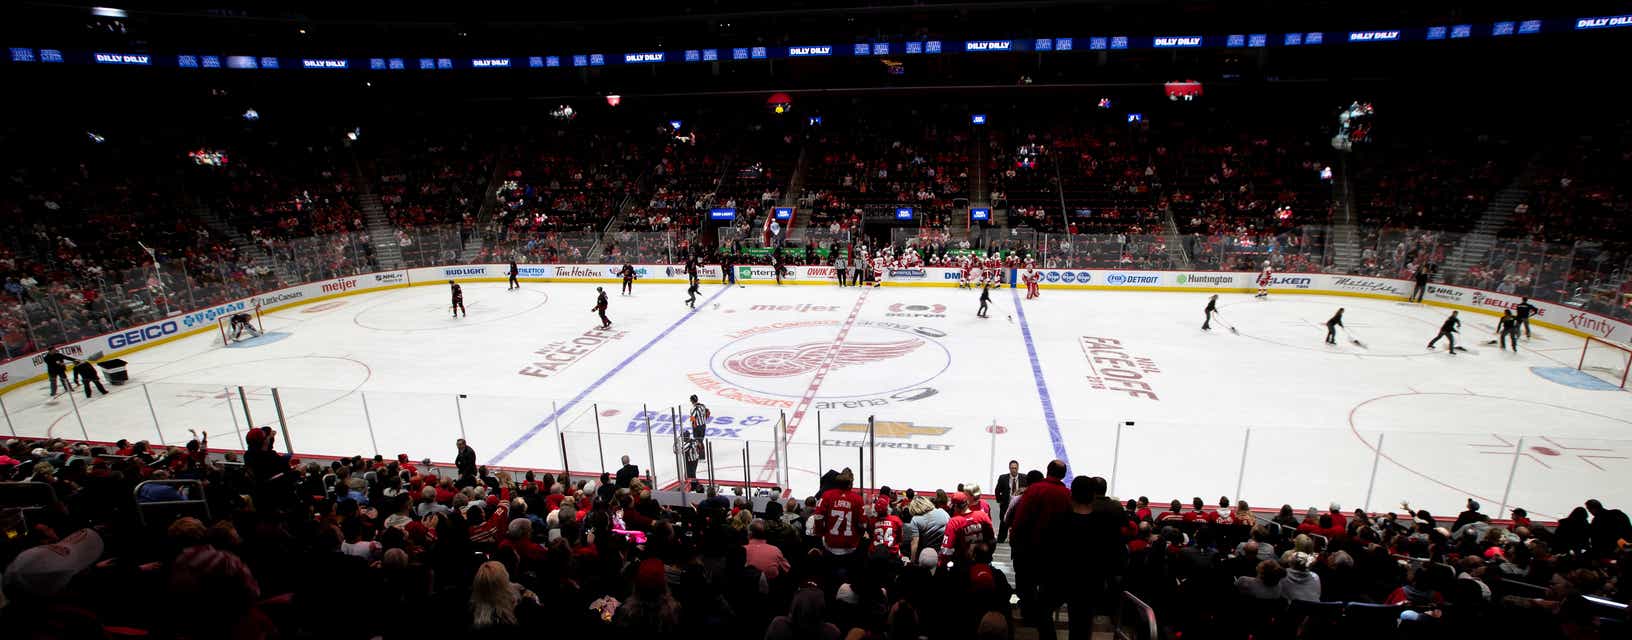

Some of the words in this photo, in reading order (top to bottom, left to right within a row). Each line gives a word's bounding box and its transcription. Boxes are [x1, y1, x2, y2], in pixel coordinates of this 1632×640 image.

[1578, 19, 1608, 27] DILLY
[1609, 17, 1632, 26] DILL
[1351, 32, 1373, 40] DILLY
[1374, 31, 1398, 39] DILLY
[967, 42, 988, 50] DILLY
[1155, 38, 1178, 46] DILLY
[1178, 37, 1200, 45] DILLY
[96, 54, 122, 62] DILLY
[123, 55, 148, 64] DILLY
[626, 54, 644, 62] DILLY
[554, 266, 571, 277] Tim
[571, 266, 601, 277] Hortons
[702, 267, 716, 275] First
[807, 267, 828, 276] QWIK
[944, 272, 961, 280] DM
[1127, 275, 1159, 284] DETROIT
[1188, 274, 1233, 285] Huntington
[321, 278, 358, 294] meijer
[750, 303, 841, 313] meijer
[1484, 297, 1517, 311] BELLE
[1568, 312, 1616, 338] xfinity
[108, 320, 178, 349] GEICO
[32, 344, 83, 368] HOCTOWN
[1082, 335, 1160, 401] FACE-OFF
[815, 398, 889, 410] arena
[739, 415, 770, 426] &
[821, 438, 956, 451] CHEVROLET
[829, 510, 853, 537] 71
[873, 527, 894, 547] 34
